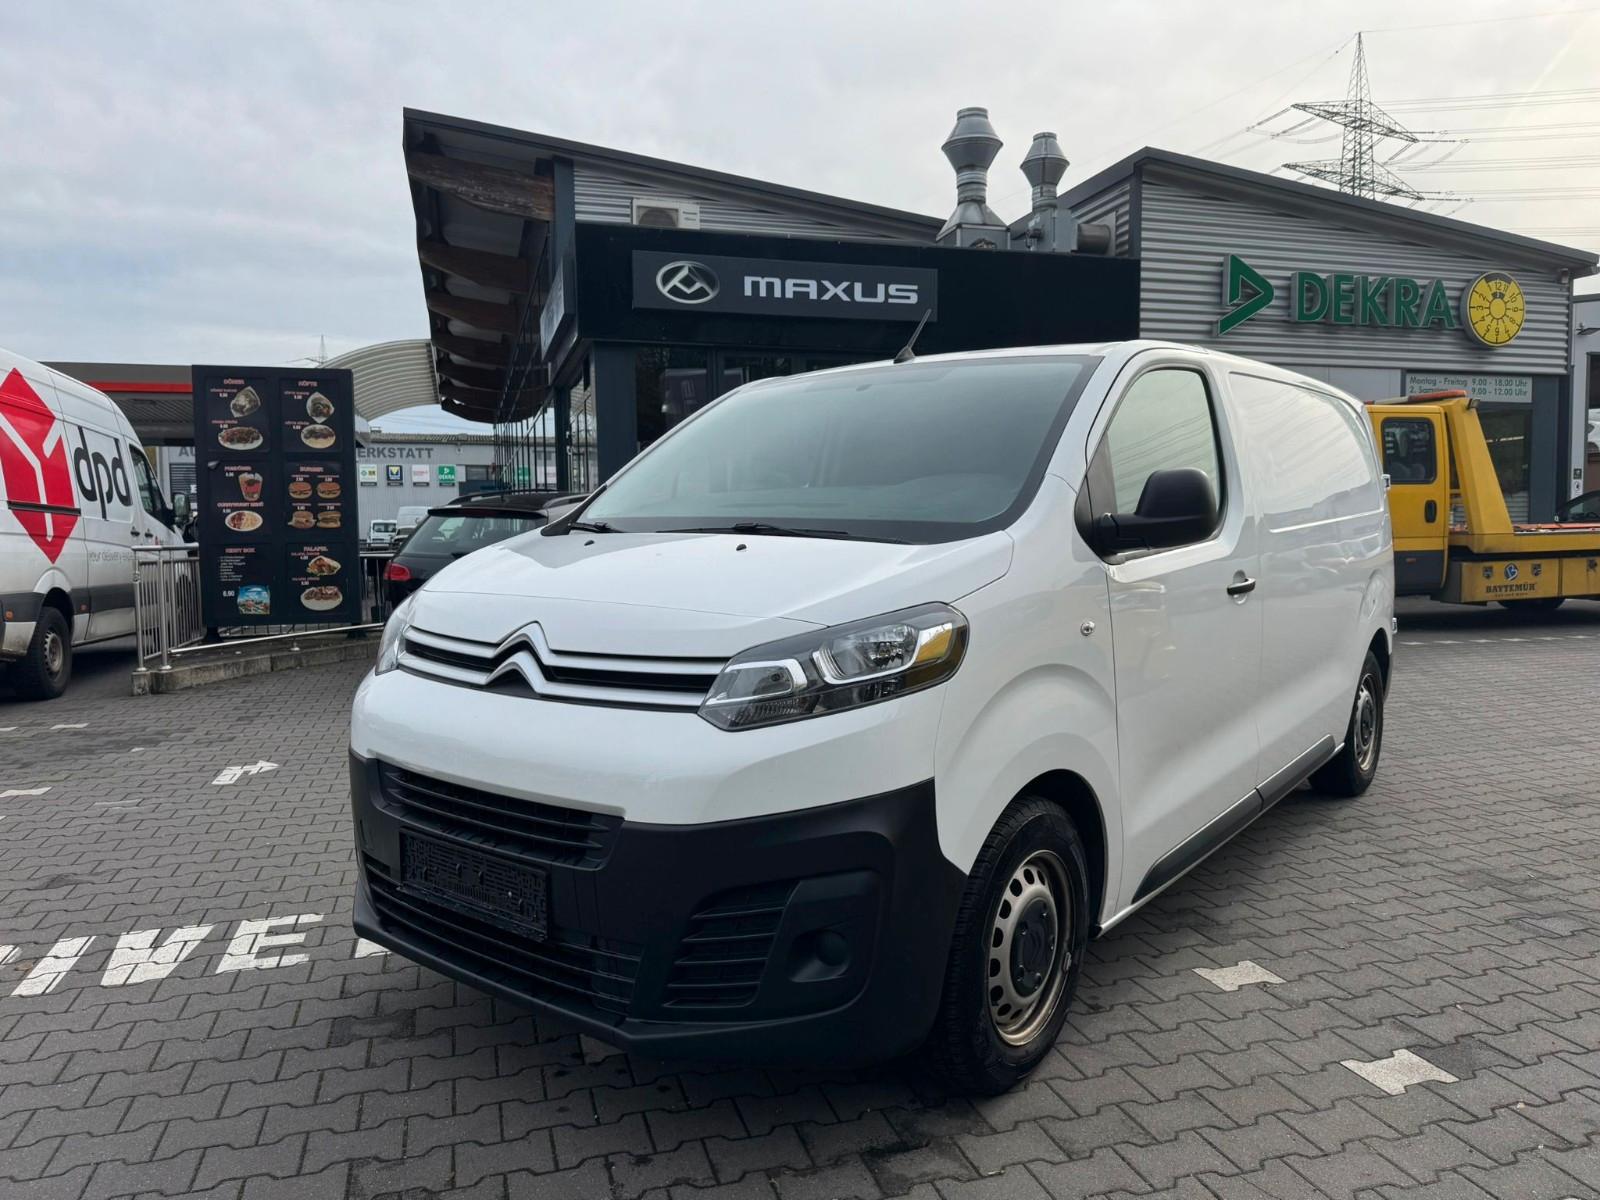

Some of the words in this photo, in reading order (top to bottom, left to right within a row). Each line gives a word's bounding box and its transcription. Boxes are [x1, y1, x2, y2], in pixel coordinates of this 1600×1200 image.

[744, 275, 918, 304] MAXUS
[1494, 281, 1502, 291] 12
[1291, 271, 1456, 329] DEKRA
[1409, 376, 1437, 387] Montag
[1443, 378, 1468, 388] Freitag
[1471, 378, 1487, 386] 9.00
[1494, 379, 1513, 387] 18.00
[1514, 379, 1529, 387] Uhr
[1409, 385, 1417, 394] 2.
[1494, 388, 1513, 396] 12.00
[74, 425, 133, 521] dpd
